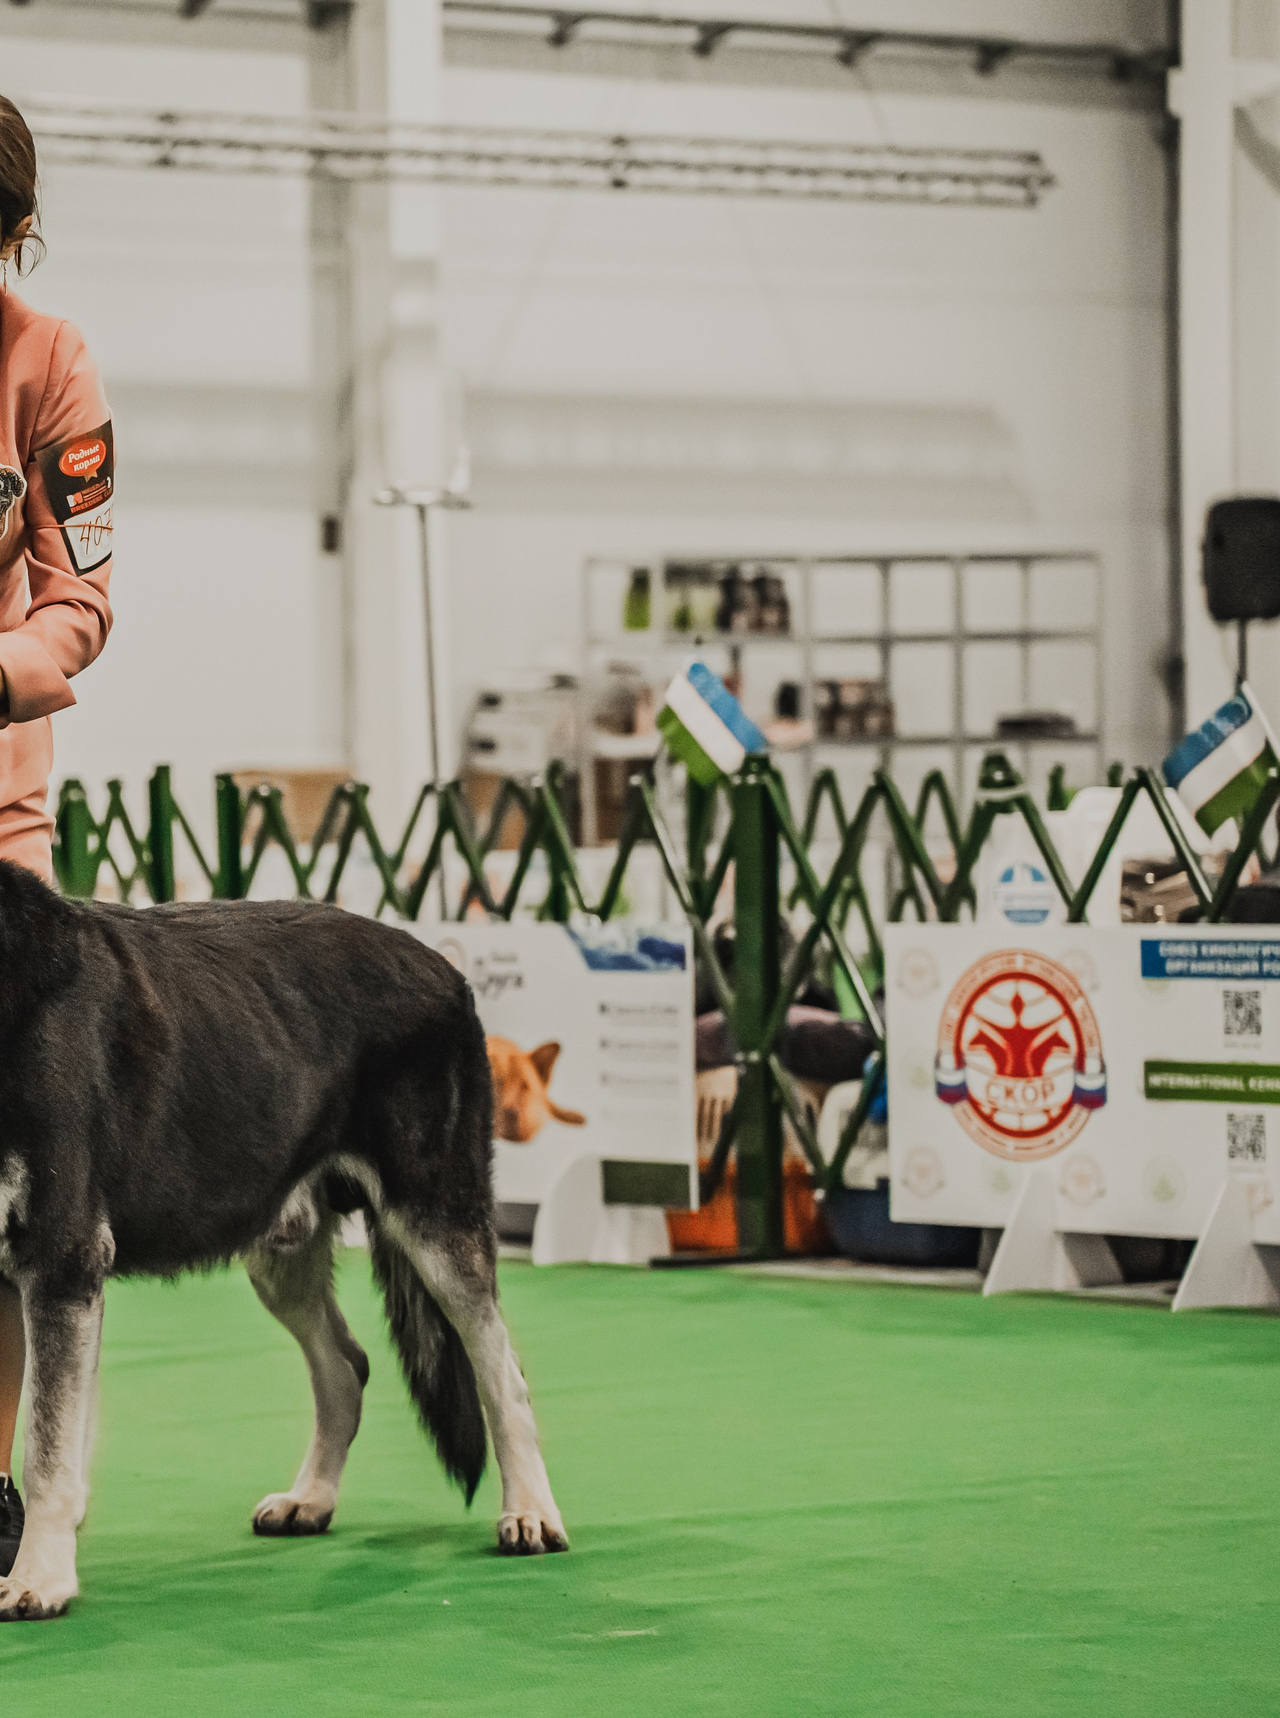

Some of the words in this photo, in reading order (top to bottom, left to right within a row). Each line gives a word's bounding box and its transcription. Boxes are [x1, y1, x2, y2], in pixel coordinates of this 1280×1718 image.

[68, 444, 100, 463] Родные
[73, 454, 100, 471] корма
[986, 1077, 1055, 1104] СКОР
